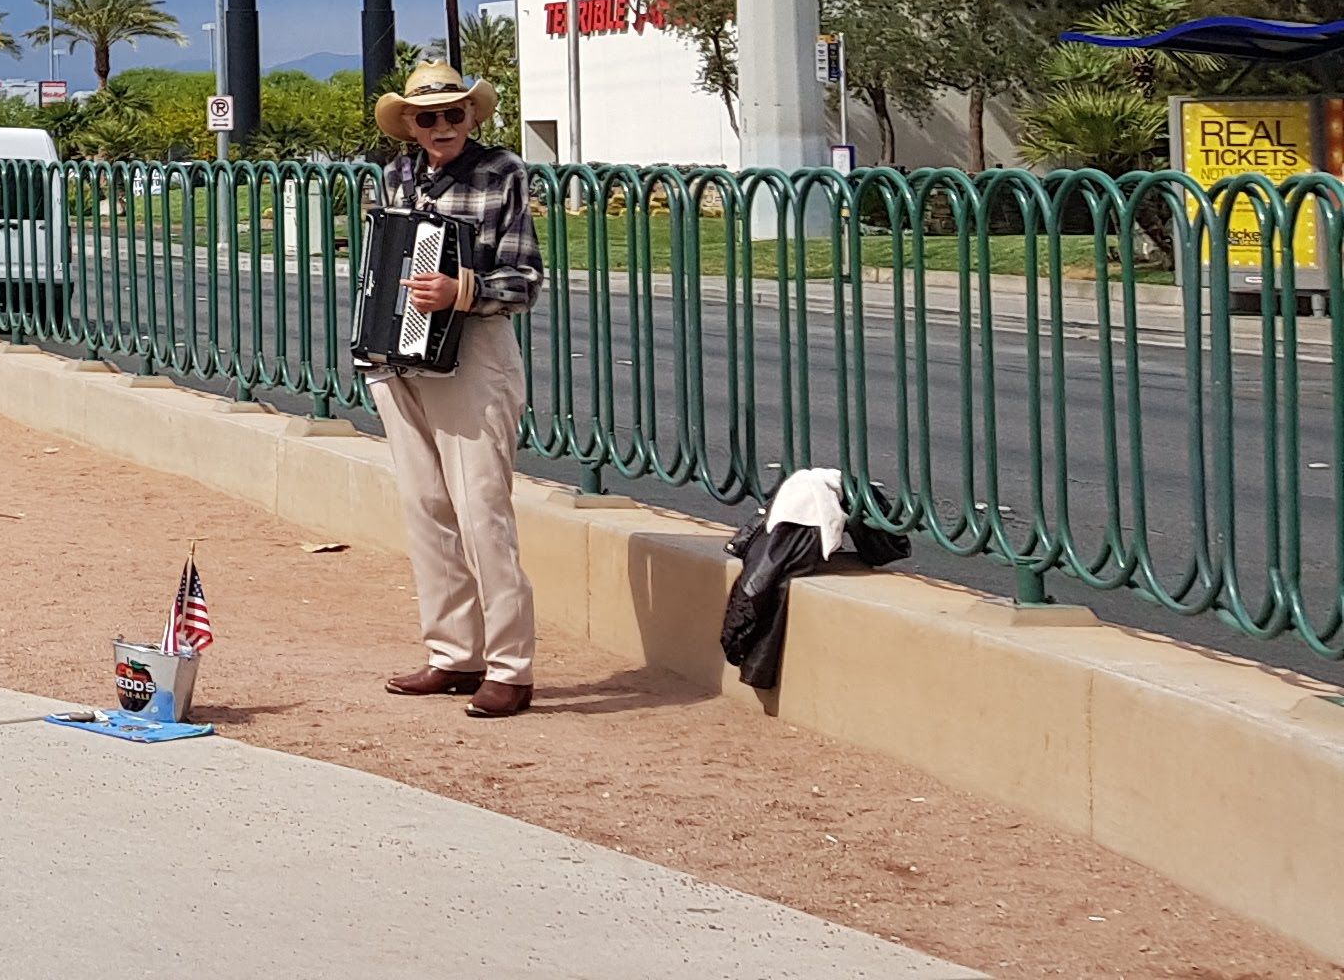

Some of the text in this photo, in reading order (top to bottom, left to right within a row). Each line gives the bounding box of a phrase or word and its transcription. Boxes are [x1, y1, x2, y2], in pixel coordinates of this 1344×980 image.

[1200, 120, 1297, 147] REAL
[1200, 149, 1298, 166] TICKETS
[1200, 168, 1227, 180] NOT
